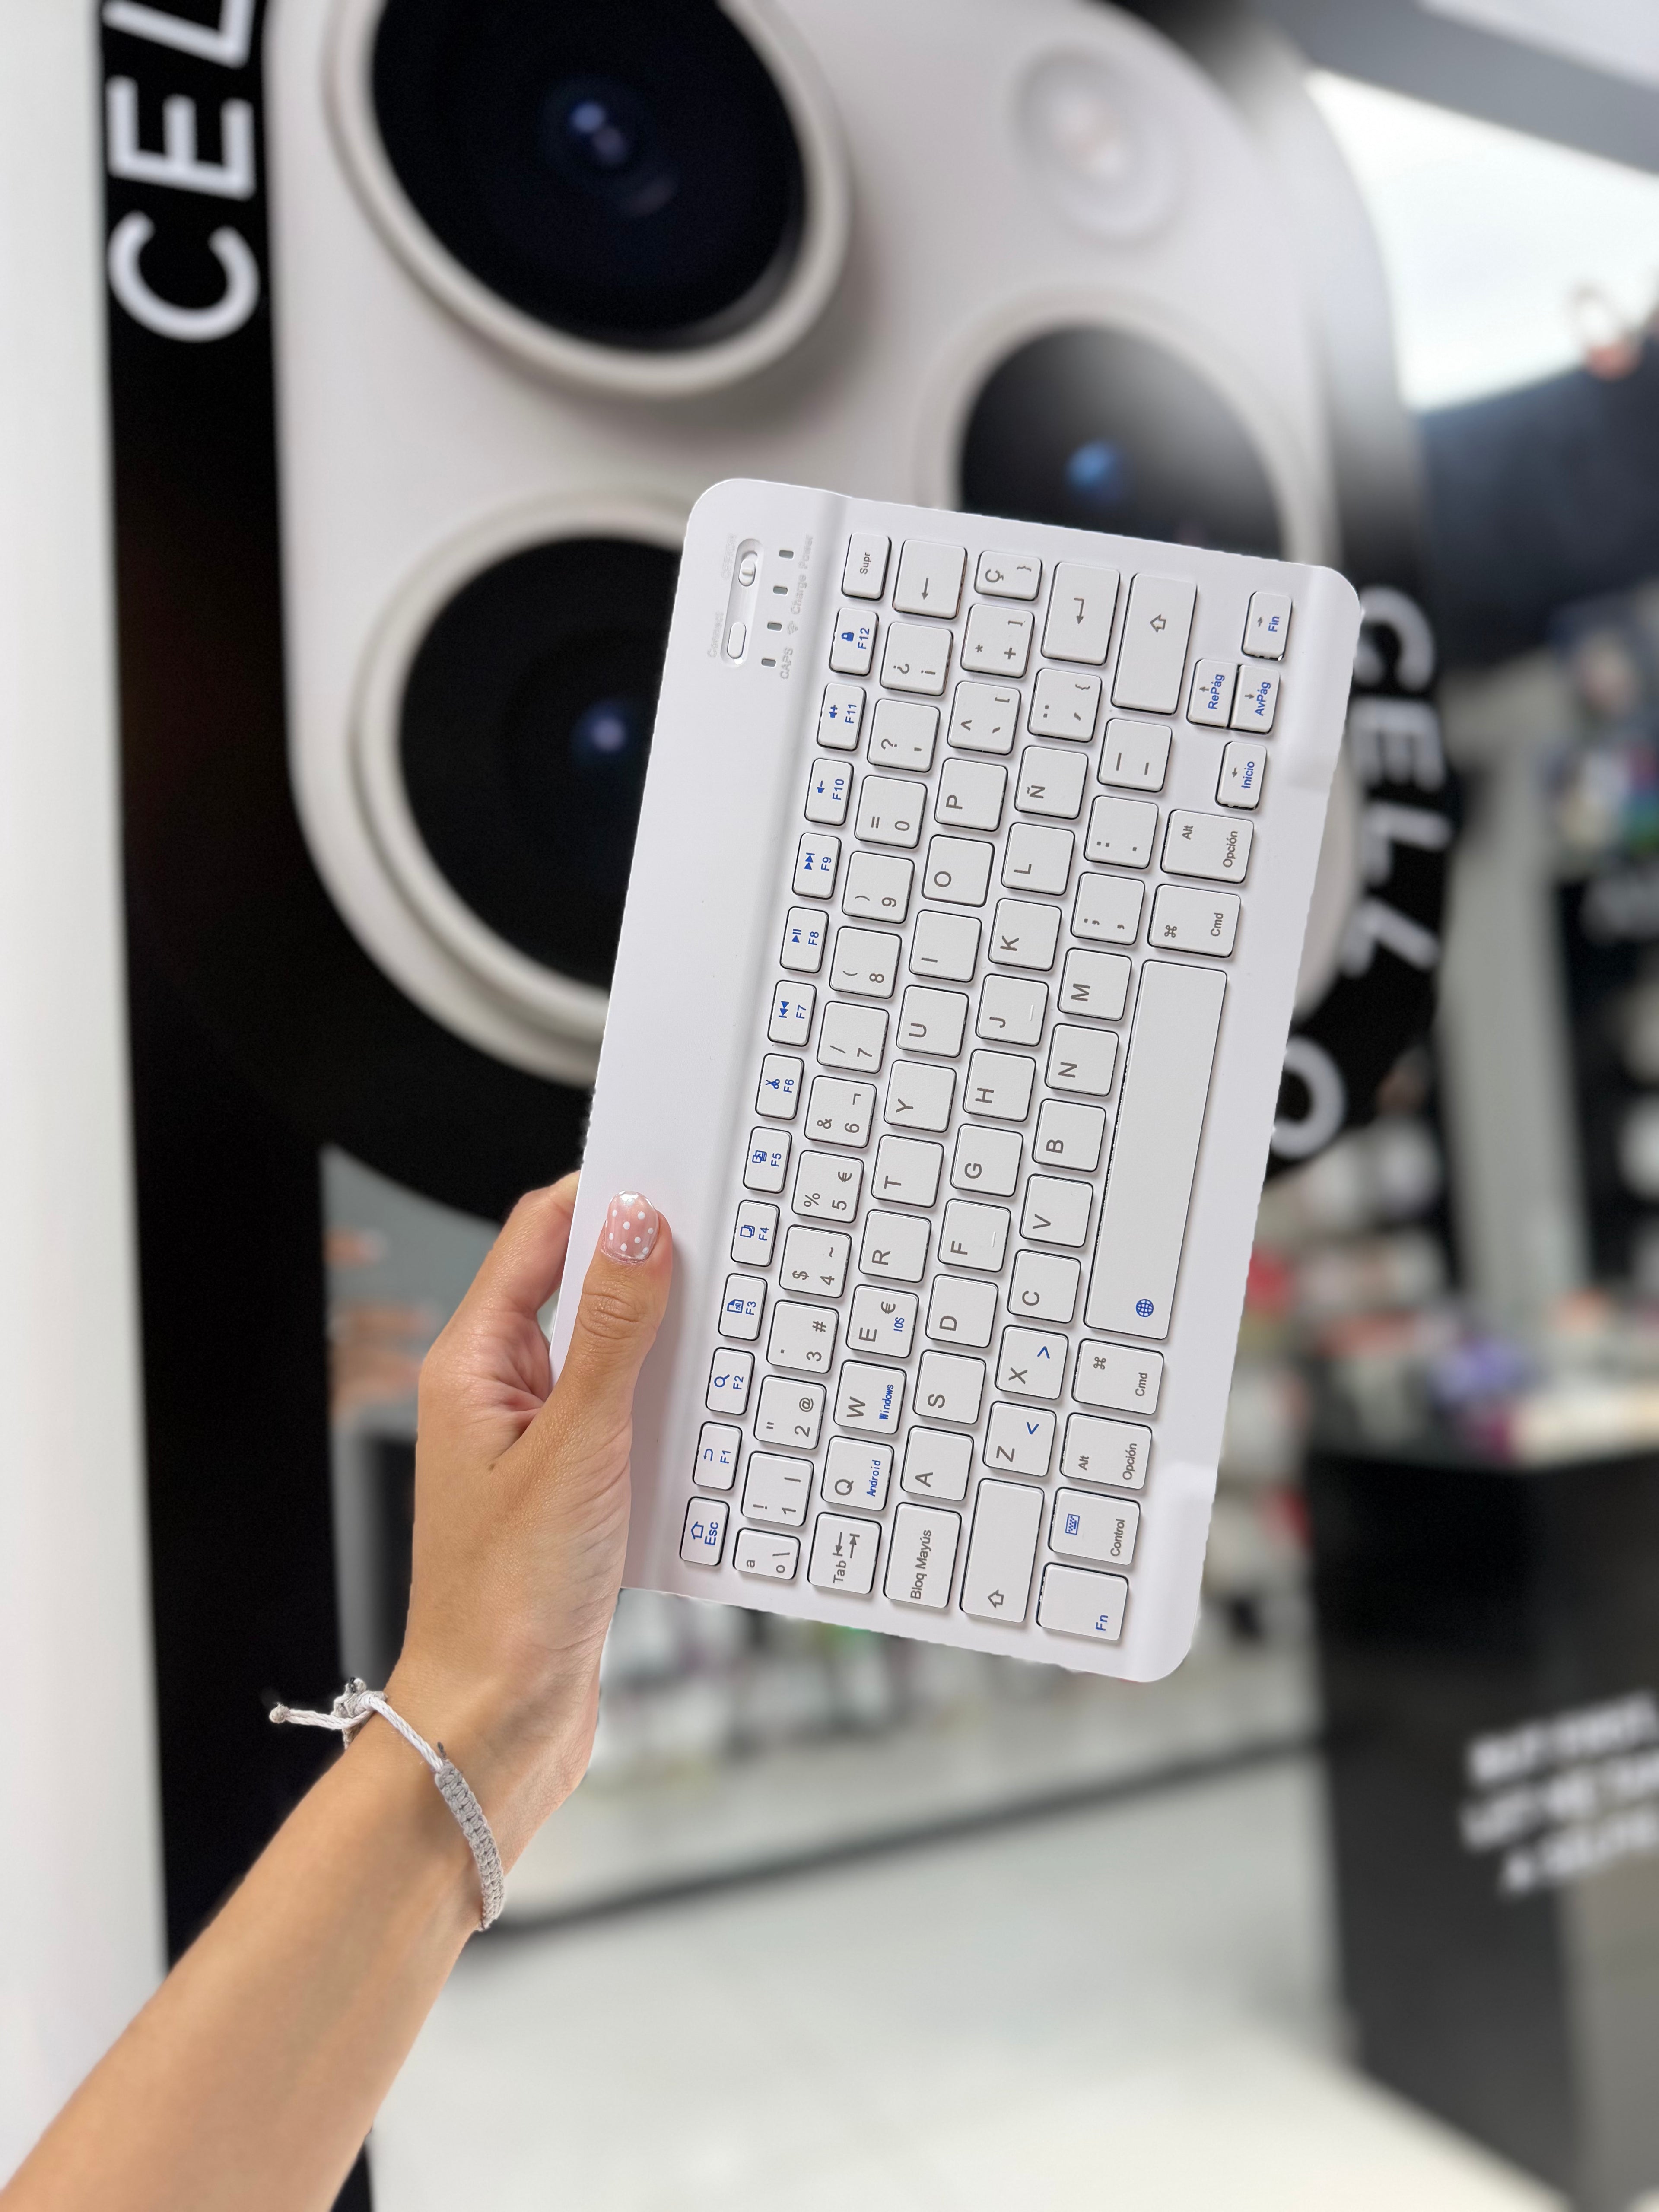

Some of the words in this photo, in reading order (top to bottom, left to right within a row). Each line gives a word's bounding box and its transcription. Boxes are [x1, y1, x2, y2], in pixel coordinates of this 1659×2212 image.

[859, 552, 871, 575] Supr
[985, 569, 1004, 583] Ç
[791, 574, 807, 615] Charge
[1268, 616, 1280, 632] Fin
[707, 612, 724, 658] Connect
[857, 627, 870, 650] F12
[1004, 647, 1016, 660] +
[780, 647, 793, 680] CAPS
[893, 663, 910, 674] ¿
[1208, 674, 1225, 709] RePág
[1254, 682, 1271, 716] AvPág
[845, 704, 857, 724] F11
[880, 738, 897, 750] ?
[1241, 761, 1255, 788] Inicio
[832, 779, 844, 801] F10
[1027, 785, 1046, 799] Ñ
[945, 795, 963, 810] P
[871, 816, 880, 829] =
[894, 820, 910, 831] 0
[1182, 825, 1194, 840] Alt
[1222, 831, 1238, 868] Opción
[820, 857, 832, 871] F9
[1013, 864, 1032, 875] L
[934, 871, 952, 888] O
[881, 897, 897, 907] 9
[1210, 912, 1224, 937] Cmd
[808, 931, 819, 946] F8
[1000, 935, 1020, 951] K
[869, 973, 884, 984] 8
[1071, 983, 1091, 1002] M
[795, 1004, 807, 1019] F7
[989, 1016, 1006, 1028] J
[909, 1022, 927, 1038] U
[857, 1047, 872, 1058] 7
[1058, 1062, 1078, 1078] N
[783, 1079, 795, 1093] F6
[975, 1087, 995, 1104] H
[896, 1098, 914, 1113] Y
[817, 1119, 833, 1130] &
[844, 1122, 860, 1133] 6
[1046, 1139, 1064, 1154] B
[770, 1153, 782, 1167] F5
[837, 1171, 852, 1183] €
[964, 1163, 982, 1179] G
[884, 1175, 902, 1189] T
[803, 1193, 820, 1208] %
[831, 1200, 847, 1211] 5
[1032, 1214, 1051, 1229] V
[758, 1227, 769, 1241] F4
[950, 1240, 968, 1255] F
[871, 1249, 891, 1265] R
[791, 1270, 810, 1281] $
[820, 1275, 835, 1286] 4
[1022, 1290, 1040, 1306] C
[745, 1301, 756, 1316] F3
[880, 1301, 896, 1314] €
[812, 1321, 826, 1332] #
[939, 1315, 957, 1332] D
[858, 1327, 877, 1342] E
[806, 1351, 822, 1362] 3
[1036, 1346, 1050, 1359] >
[733, 1375, 744, 1390] F2
[1008, 1367, 1028, 1385] X
[1135, 1372, 1148, 1397] Cmd
[799, 1397, 814, 1413] @
[846, 1396, 866, 1418] W
[879, 1384, 894, 1420] Windows
[927, 1393, 945, 1408] S
[794, 1425, 810, 1437] 2
[1026, 1421, 1039, 1435] <
[720, 1450, 731, 1464] F1
[996, 1446, 1015, 1462] Z
[1078, 1455, 1090, 1471] Alt
[1122, 1443, 1137, 1481] Opción
[866, 1459, 881, 1497] Android
[915, 1472, 934, 1488] A
[834, 1478, 854, 1496] Q
[704, 1522, 719, 1546] Esc
[1110, 1518, 1125, 1557] Control
[915, 1529, 932, 1570] Mayús
[833, 1560, 847, 1583] Tab
[910, 1572, 927, 1599] Bloq
[1095, 1615, 1109, 1631] Fn
